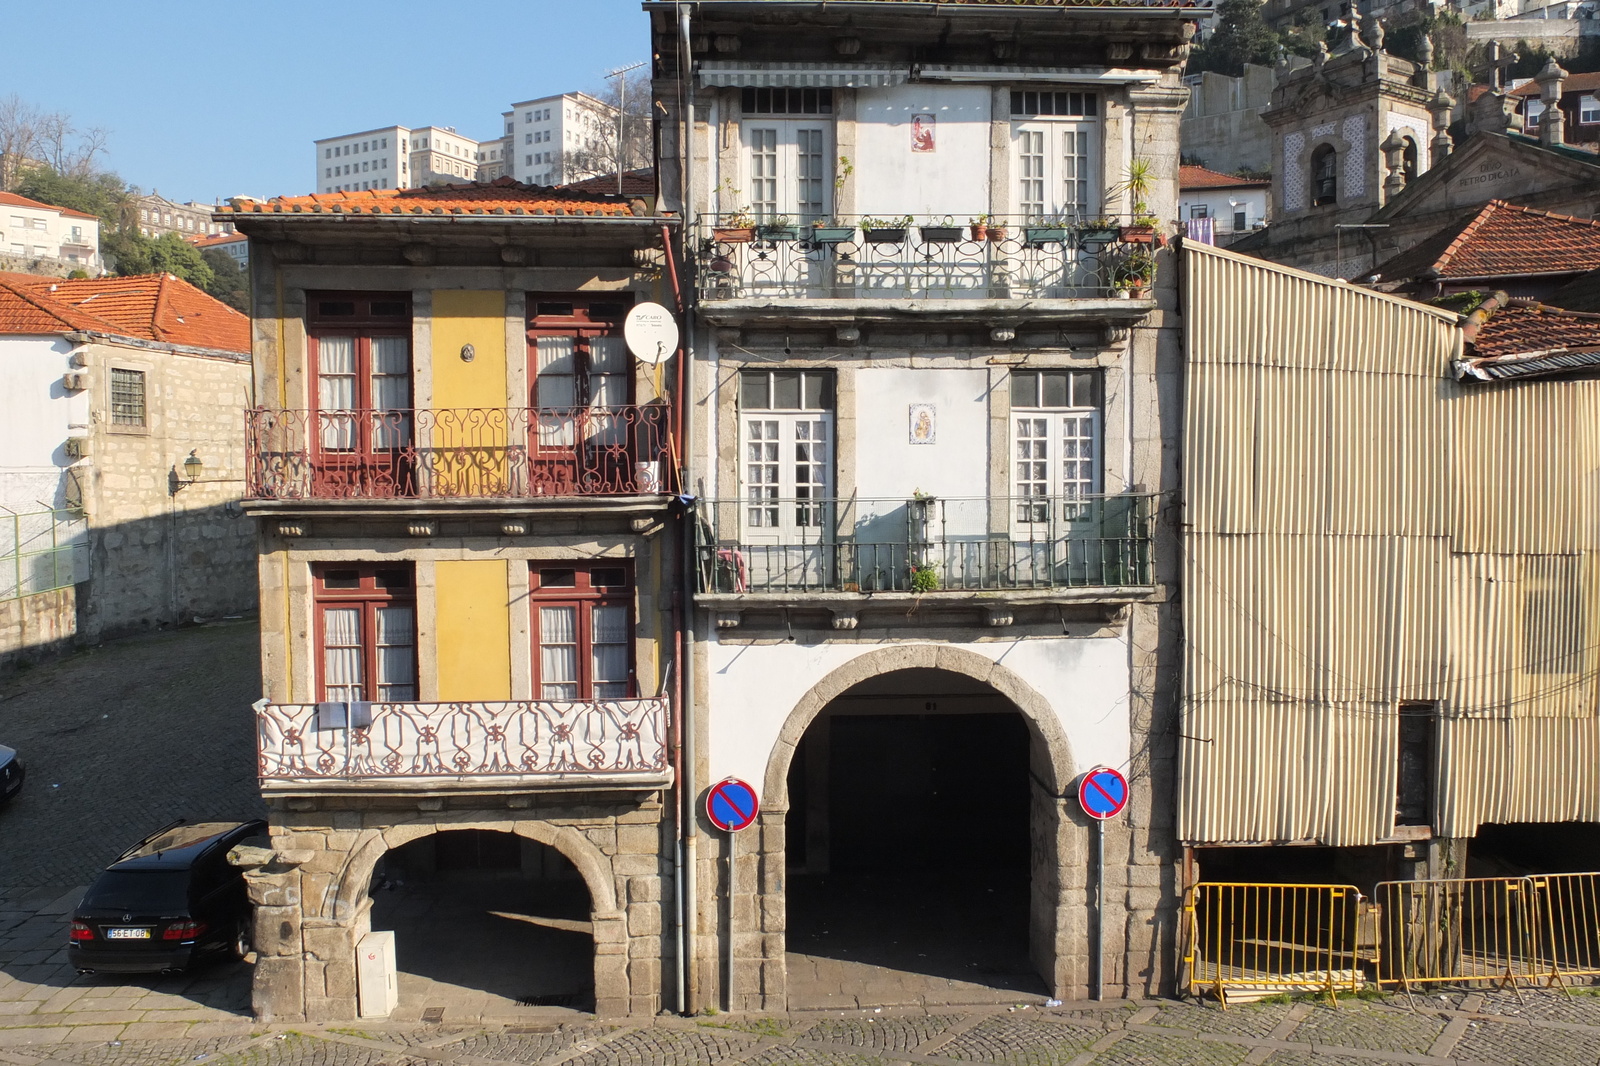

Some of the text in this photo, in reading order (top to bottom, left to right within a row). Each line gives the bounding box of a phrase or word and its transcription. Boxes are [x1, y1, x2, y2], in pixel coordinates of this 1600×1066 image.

[1480, 162, 1502, 173] DIVO
[1459, 168, 1520, 187] PETRO DICATA
